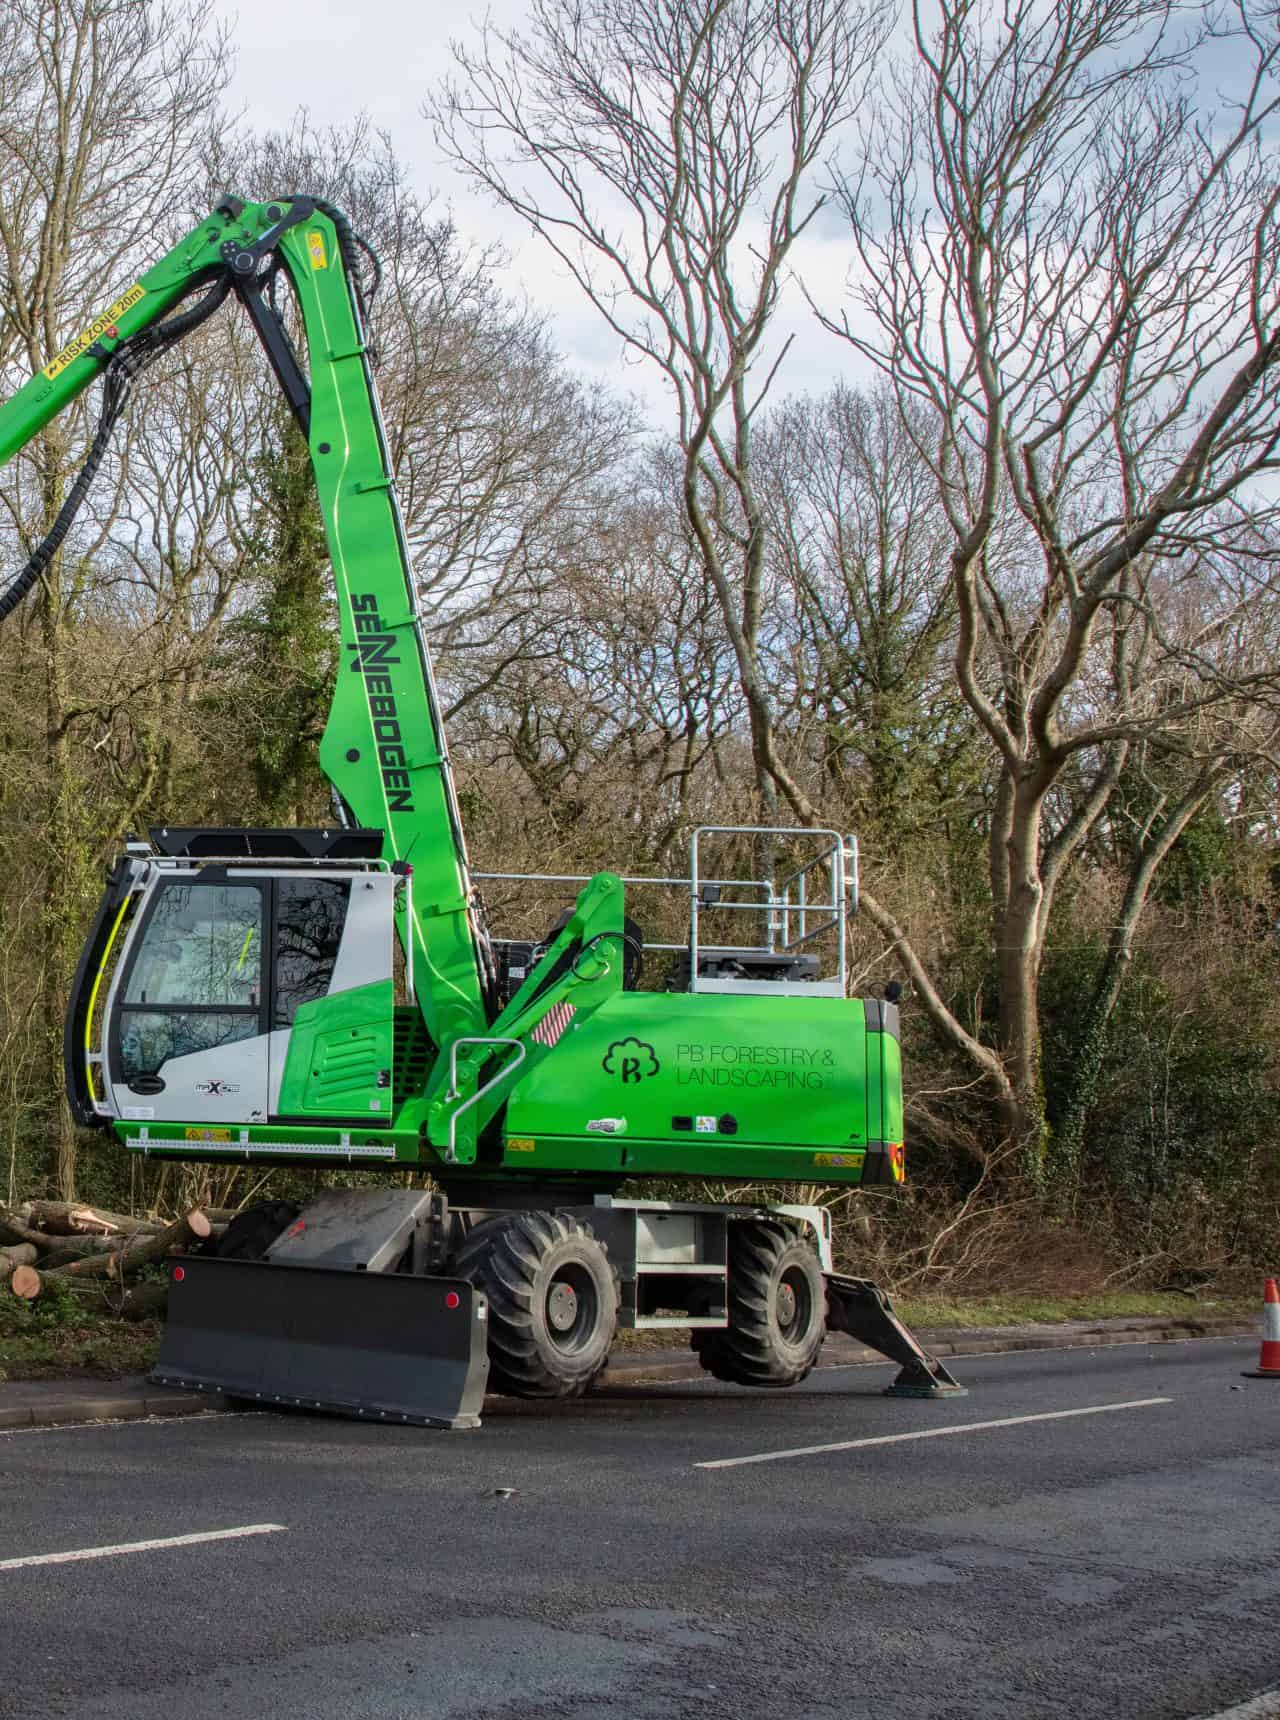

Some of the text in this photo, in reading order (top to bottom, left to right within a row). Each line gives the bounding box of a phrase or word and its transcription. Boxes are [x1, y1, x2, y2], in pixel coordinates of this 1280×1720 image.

[58, 288, 142, 366] RISK ZONE 20m
[675, 1044, 835, 1066] PB FORESTRY &
[675, 1068, 824, 1089] LANDSCAPING
